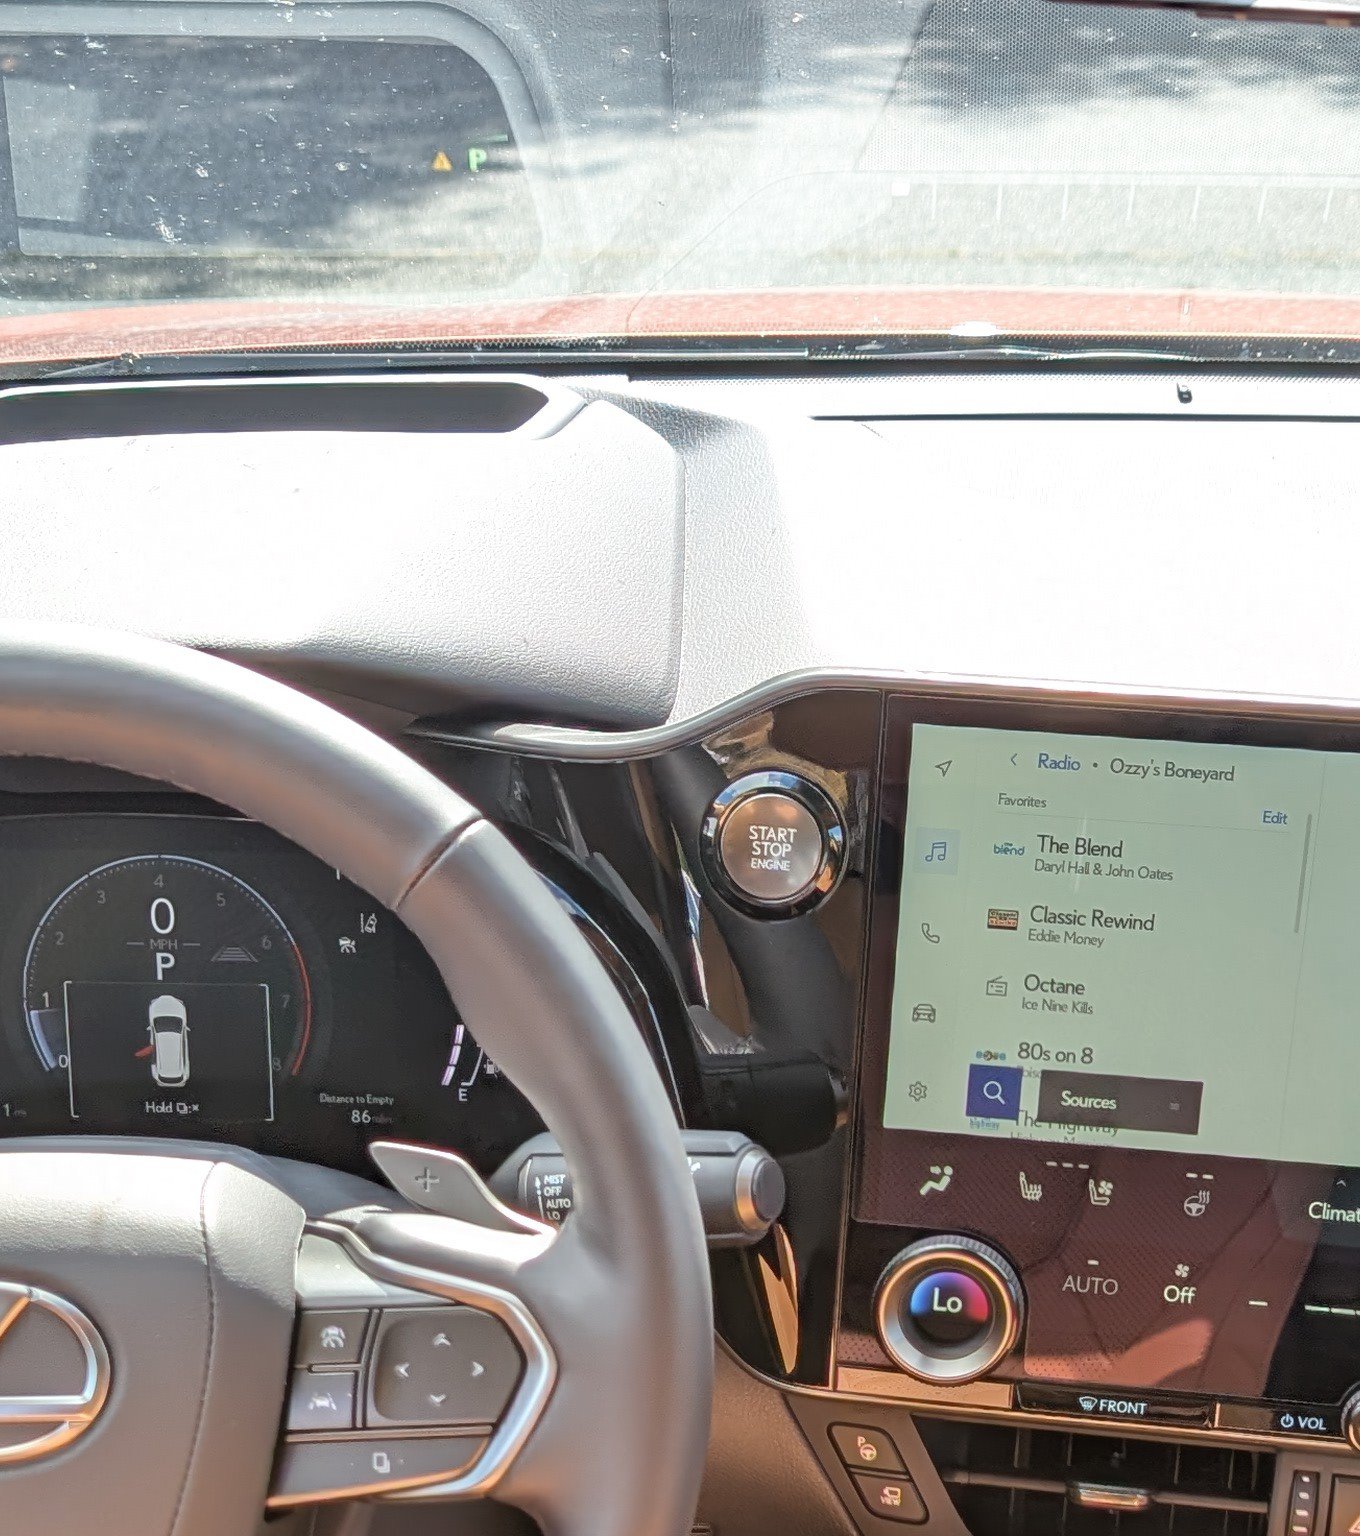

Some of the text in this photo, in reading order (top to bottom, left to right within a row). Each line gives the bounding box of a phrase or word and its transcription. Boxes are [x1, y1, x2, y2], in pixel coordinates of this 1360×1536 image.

[468, 148, 486, 172] P
[1038, 753, 1235, 783] Radio Ozzy's Boneyard
[998, 793, 1047, 808] Favorites
[1262, 810, 1288, 825] Edit
[749, 825, 797, 843] START
[752, 841, 792, 857] STOP
[1037, 835, 1123, 858] The Blend
[750, 858, 791, 871] ENGINE
[1035, 859, 1173, 881] Daryl Hall & John Oates
[154, 874, 165, 888] 4
[97, 889, 106, 904] 3
[216, 891, 226, 906] 5
[151, 898, 175, 934] 0
[1030, 905, 1086, 926] Classic
[1092, 909, 1156, 931] Rewind
[55, 931, 65, 945] 2
[150, 939, 178, 950] MPH
[1028, 928, 1105, 948] Eddie Money
[156, 952, 175, 980] P
[1024, 973, 1085, 995] Octane
[42, 991, 50, 1007] 1
[1022, 997, 1093, 1015] Ice Nine Kills
[1017, 1041, 1051, 1061] 80s
[1055, 1050, 1076, 1063] on
[1081, 1047, 1094, 1065] 8
[59, 1055, 68, 1068] 0
[319, 1093, 394, 1105] Distance to Empty
[458, 1088, 468, 1102] E
[1061, 1090, 1117, 1110] Sources
[145, 1101, 173, 1113] Hold
[351, 1109, 371, 1123] 86
[543, 1186, 562, 1197] OFF
[546, 1198, 571, 1209] AUTO
[1062, 1275, 1119, 1295] AUTO
[932, 1287, 963, 1314] Lo
[1164, 1285, 1197, 1304] Off
[1099, 1399, 1148, 1415] FRONT
[1297, 1416, 1326, 1430] VOL
